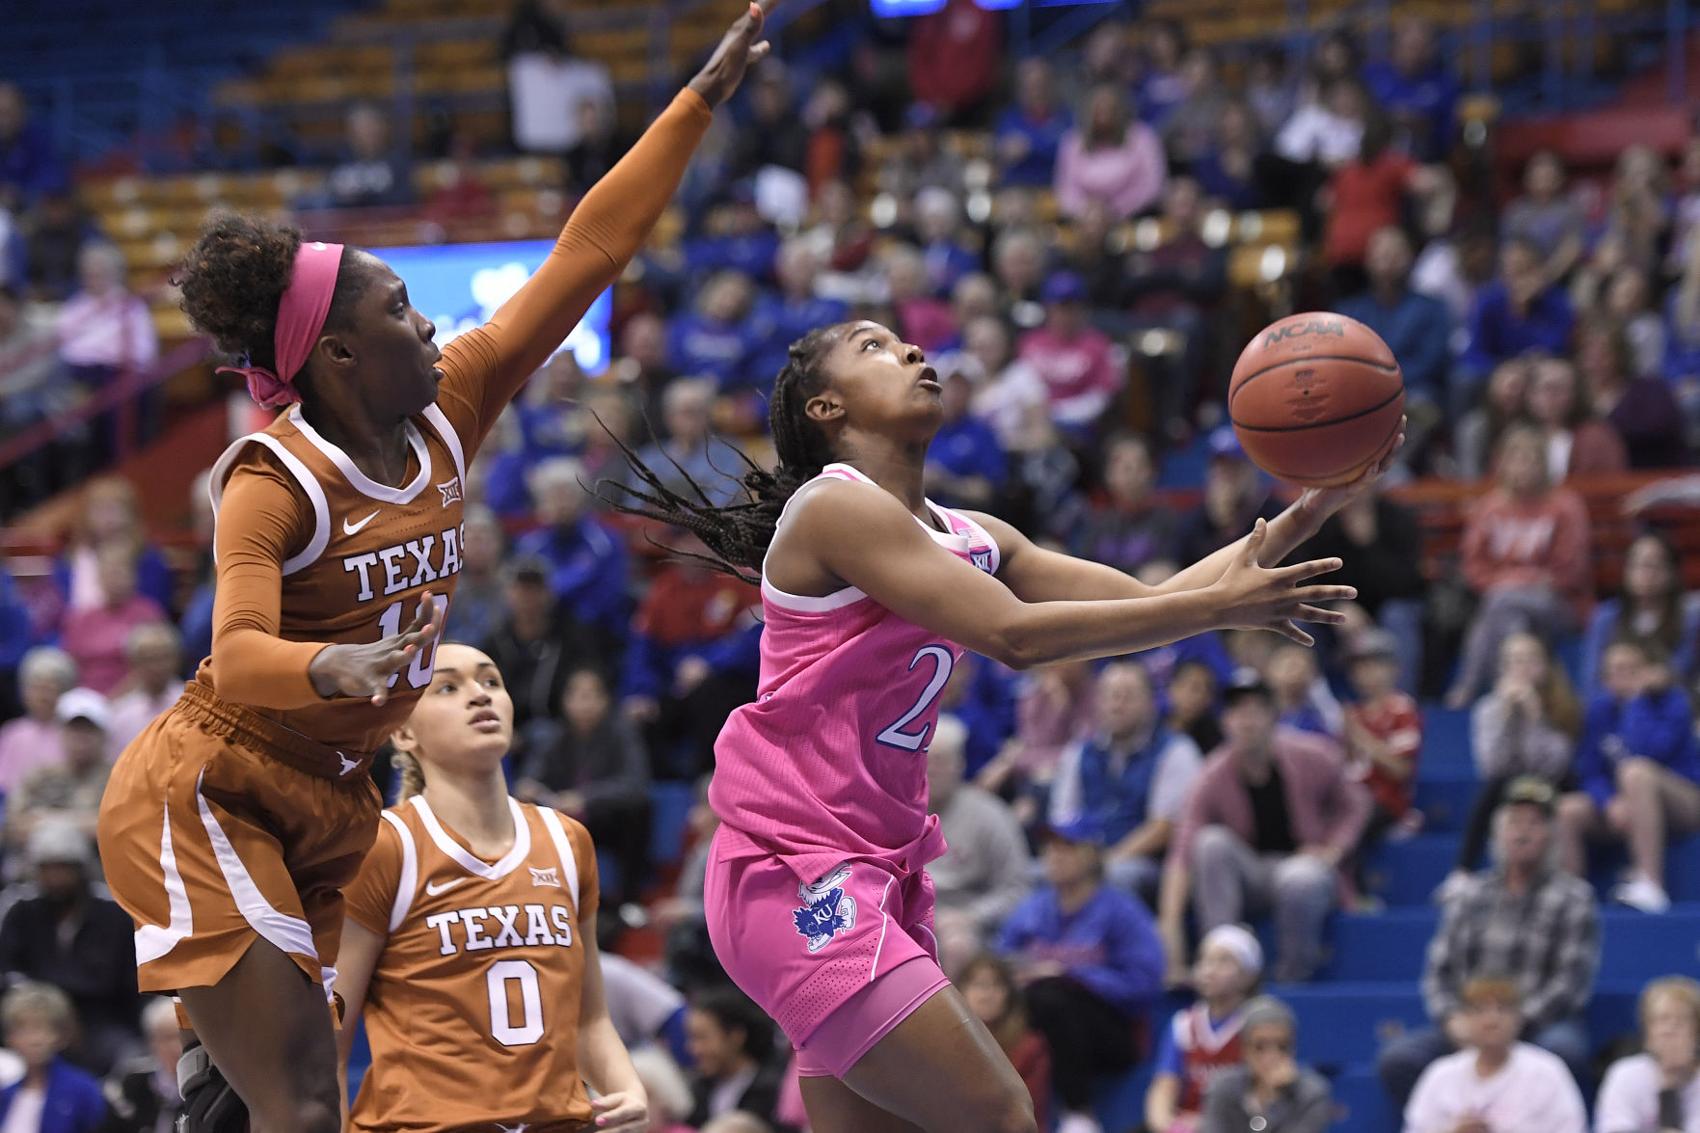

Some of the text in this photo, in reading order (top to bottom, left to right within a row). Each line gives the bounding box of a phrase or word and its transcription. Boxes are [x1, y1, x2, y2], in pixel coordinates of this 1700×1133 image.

[1263, 320, 1345, 348] NCAA
[876, 643, 954, 752] 2
[425, 903, 573, 956] TEXAS
[813, 904, 833, 925] KU
[486, 959, 545, 1047] 0
